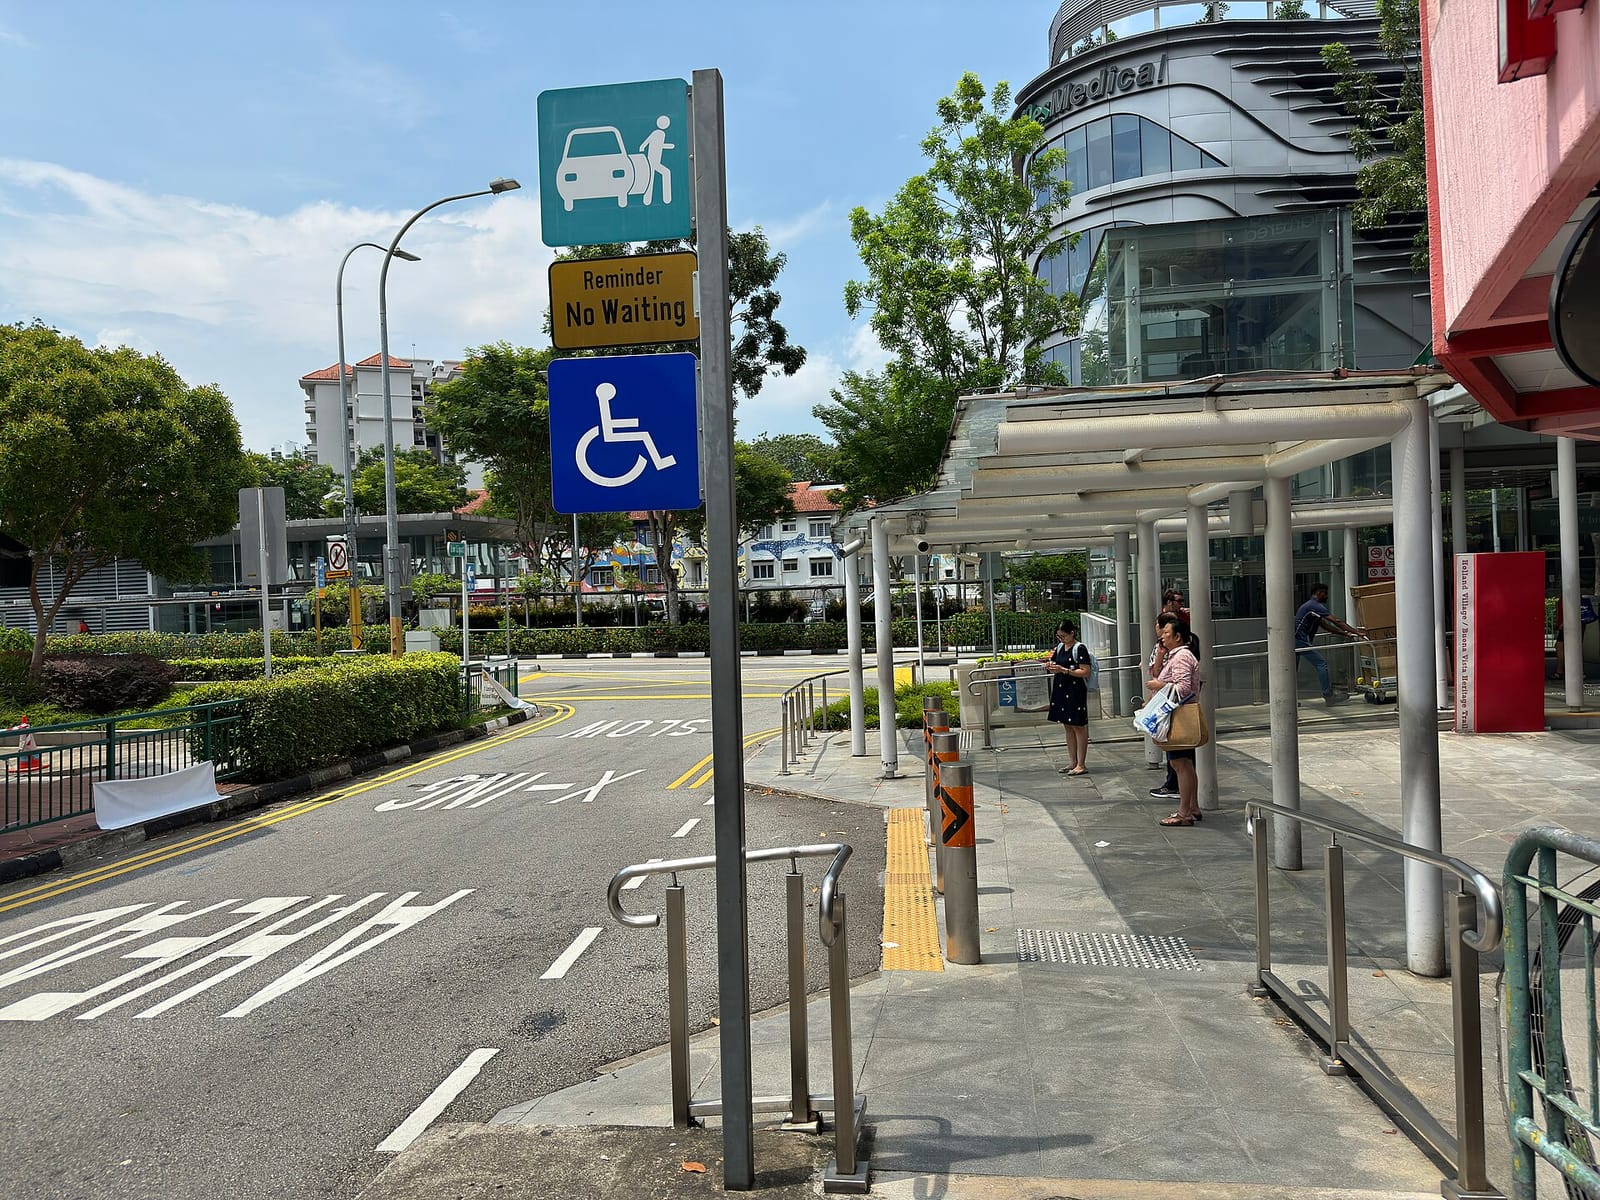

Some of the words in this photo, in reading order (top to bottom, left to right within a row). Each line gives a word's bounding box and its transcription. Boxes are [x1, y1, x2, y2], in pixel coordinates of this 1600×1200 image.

[584, 266, 663, 290] Reminder
[566, 301, 595, 327] No
[602, 295, 686, 327] Waiting
[556, 719, 712, 738] SLOW
